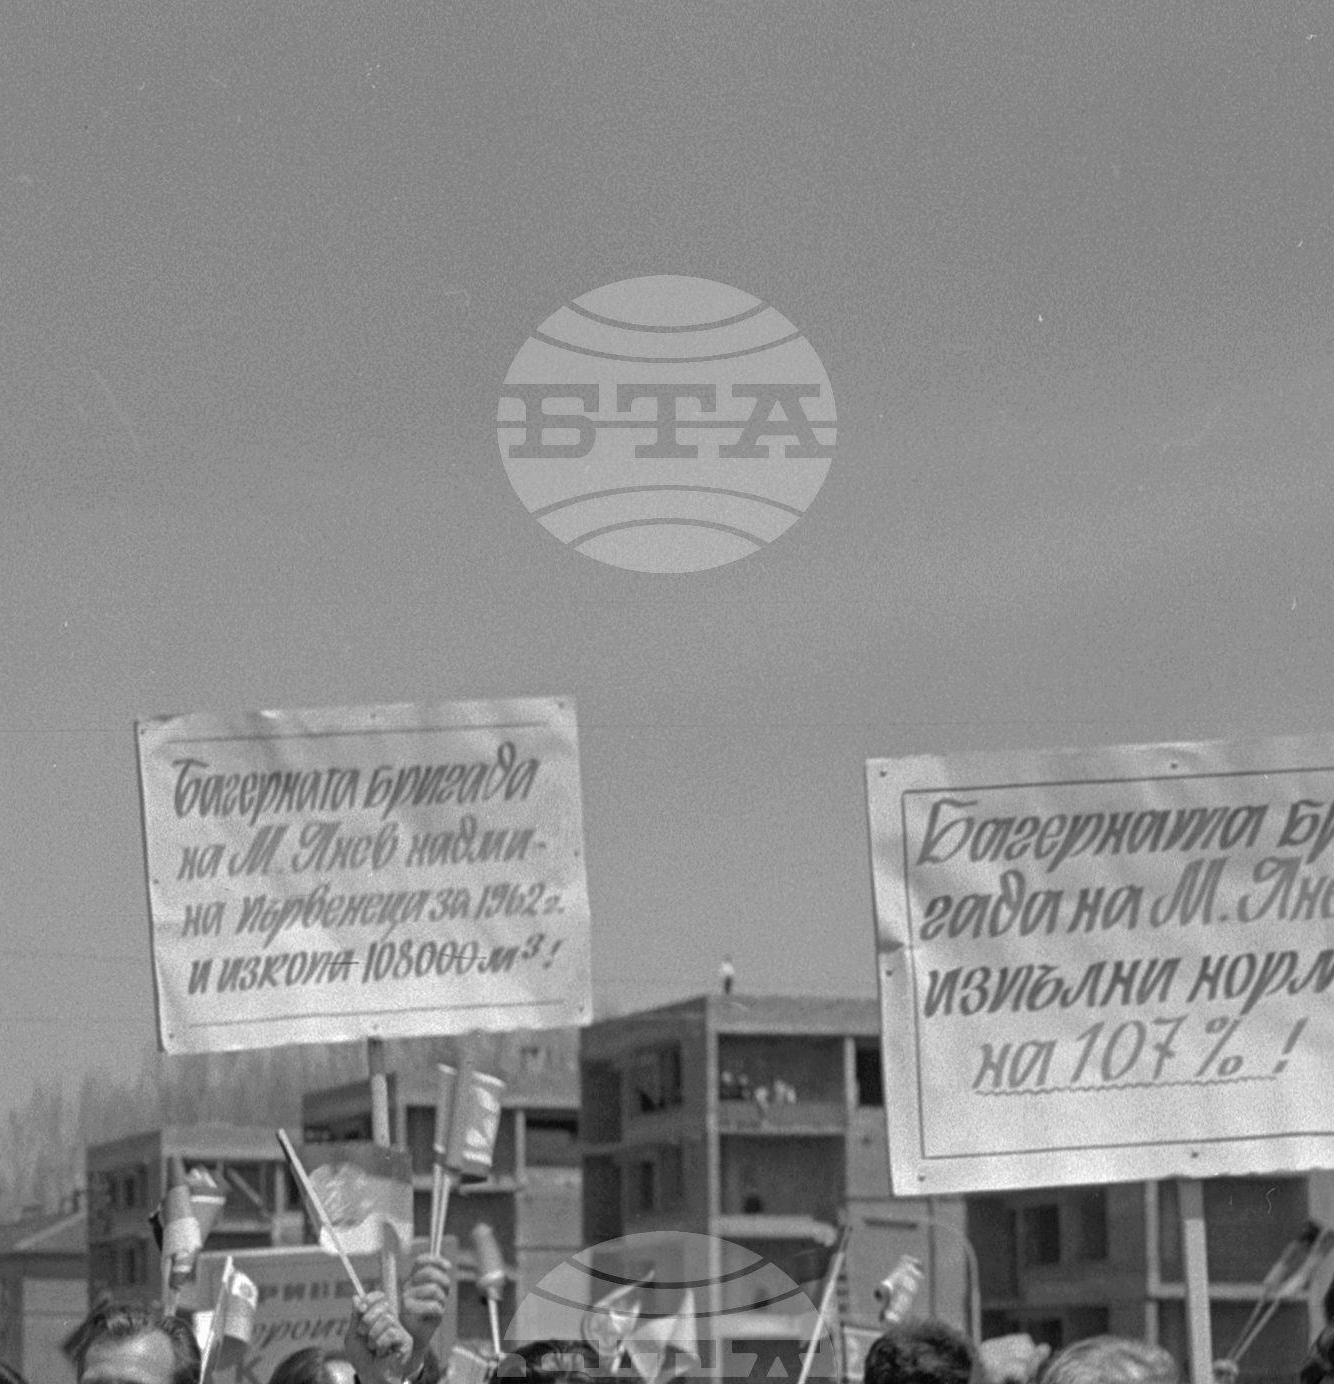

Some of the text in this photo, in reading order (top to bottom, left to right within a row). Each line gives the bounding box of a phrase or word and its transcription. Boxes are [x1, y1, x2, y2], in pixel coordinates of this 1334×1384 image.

[172, 740, 541, 828] Багерната Бригада
[177, 843, 227, 881] на
[916, 797, 1270, 874] Багерната
[180, 900, 227, 938] на
[428, 886, 472, 923] за
[919, 867, 1065, 942] гада
[1066, 884, 1145, 934] на
[187, 957, 214, 996] и
[216, 948, 356, 994] изкопа
[923, 956, 1182, 1019] изпълни
[970, 1038, 1059, 1091] на
